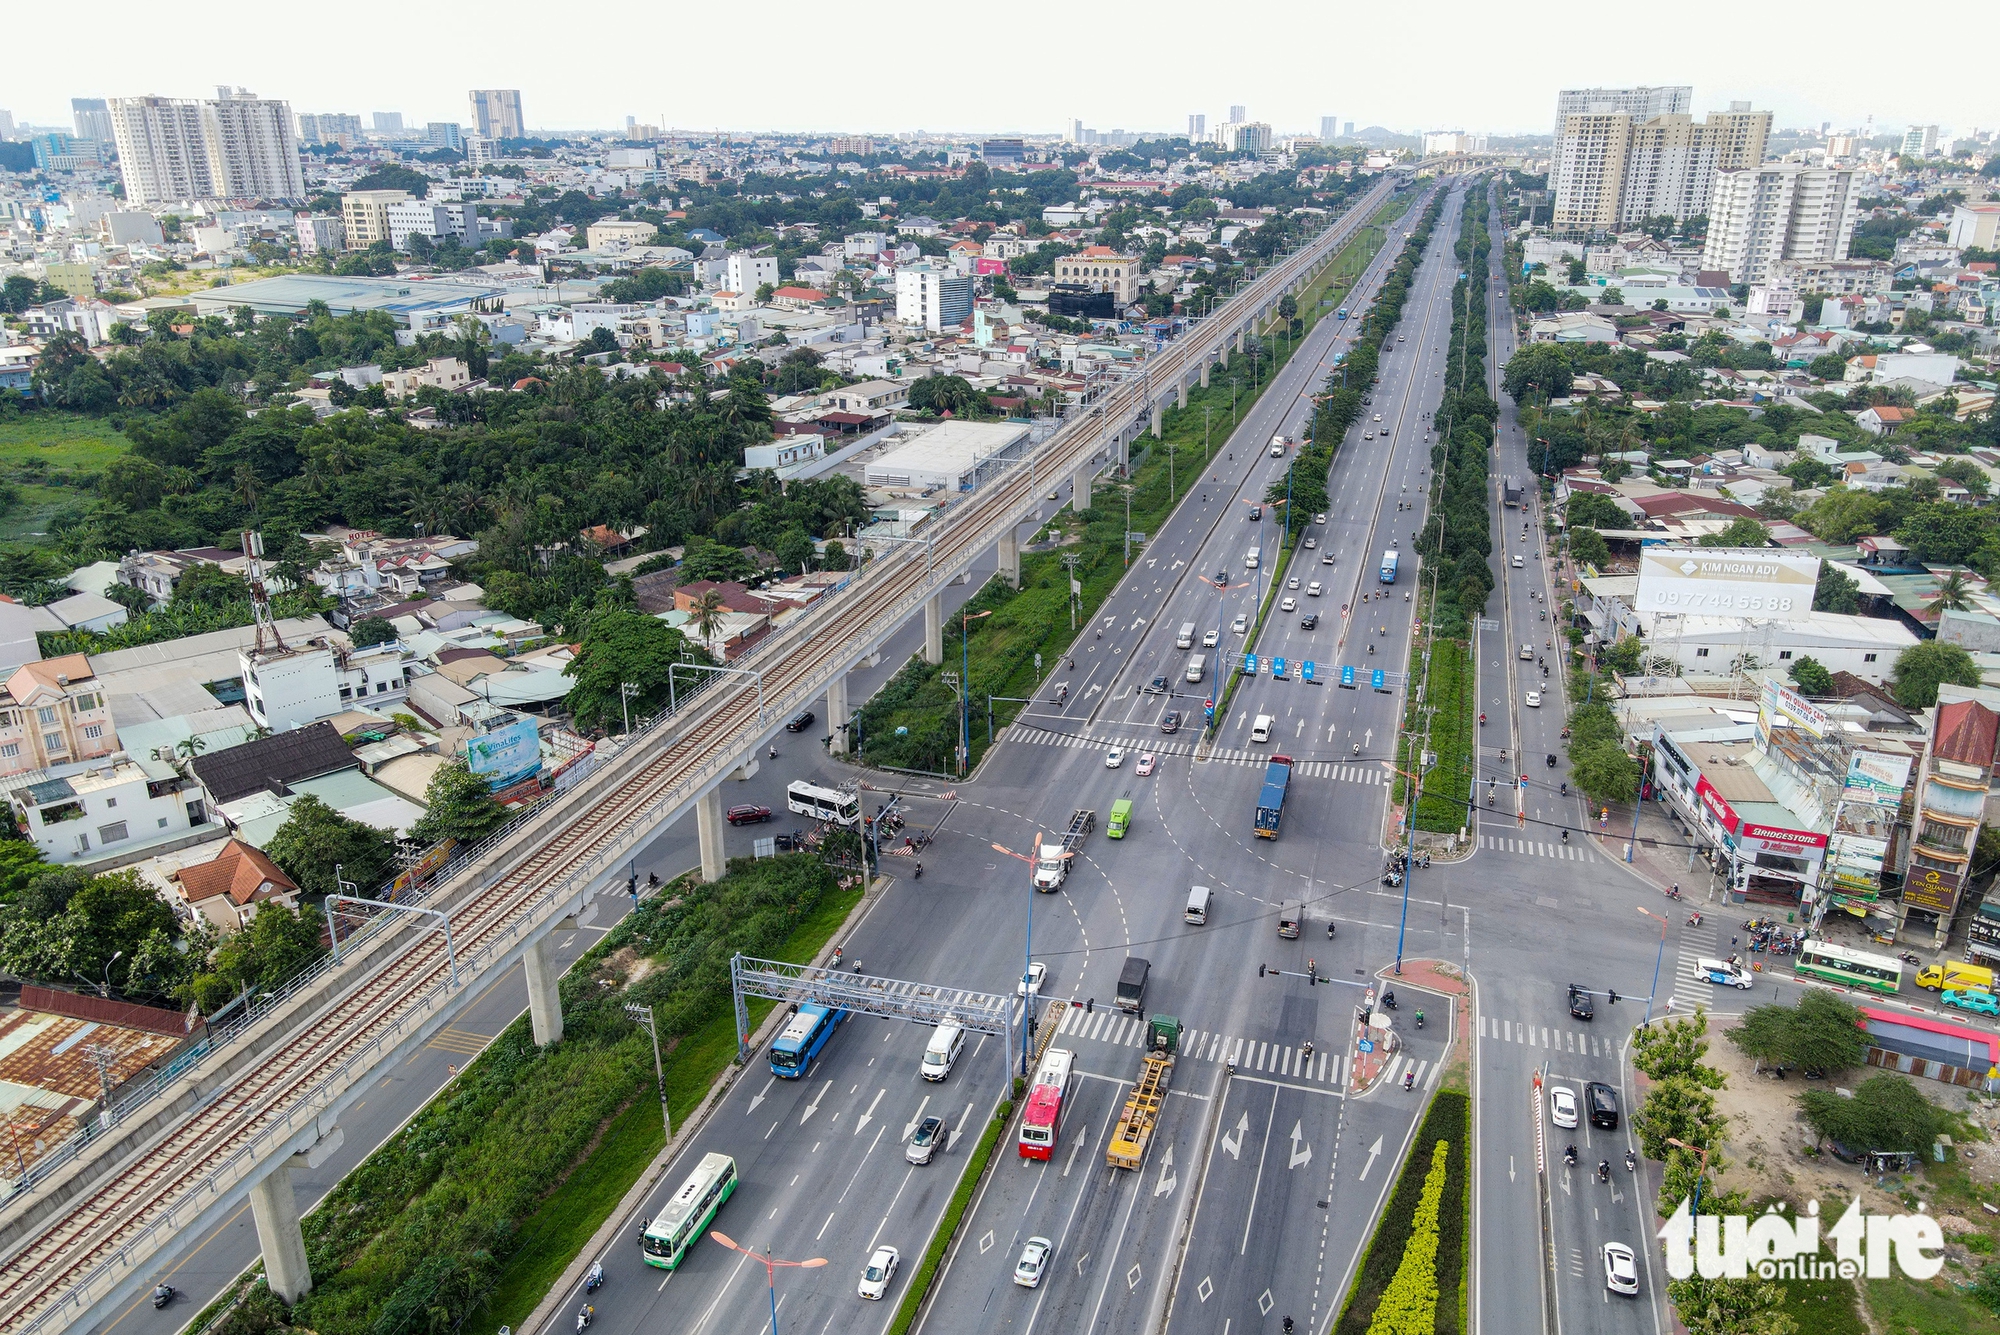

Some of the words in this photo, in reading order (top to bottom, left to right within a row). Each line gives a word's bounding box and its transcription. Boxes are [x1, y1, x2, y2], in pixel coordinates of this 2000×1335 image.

[349, 530, 376, 540] HOTEL
[1701, 562, 1722, 572] KIM
[1723, 563, 1754, 574] NGAN
[1756, 565, 1779, 575] ADV
[1655, 591, 1680, 605] 09
[1683, 592, 1707, 606] 77
[1709, 594, 1734, 608] 44
[1738, 595, 1763, 610] 55
[1766, 597, 1792, 612] 88
[487, 734, 521, 751] VinaLifes
[1752, 827, 1818, 844] BRIDGESTONE
[1979, 926, 1991, 936] Dr.
